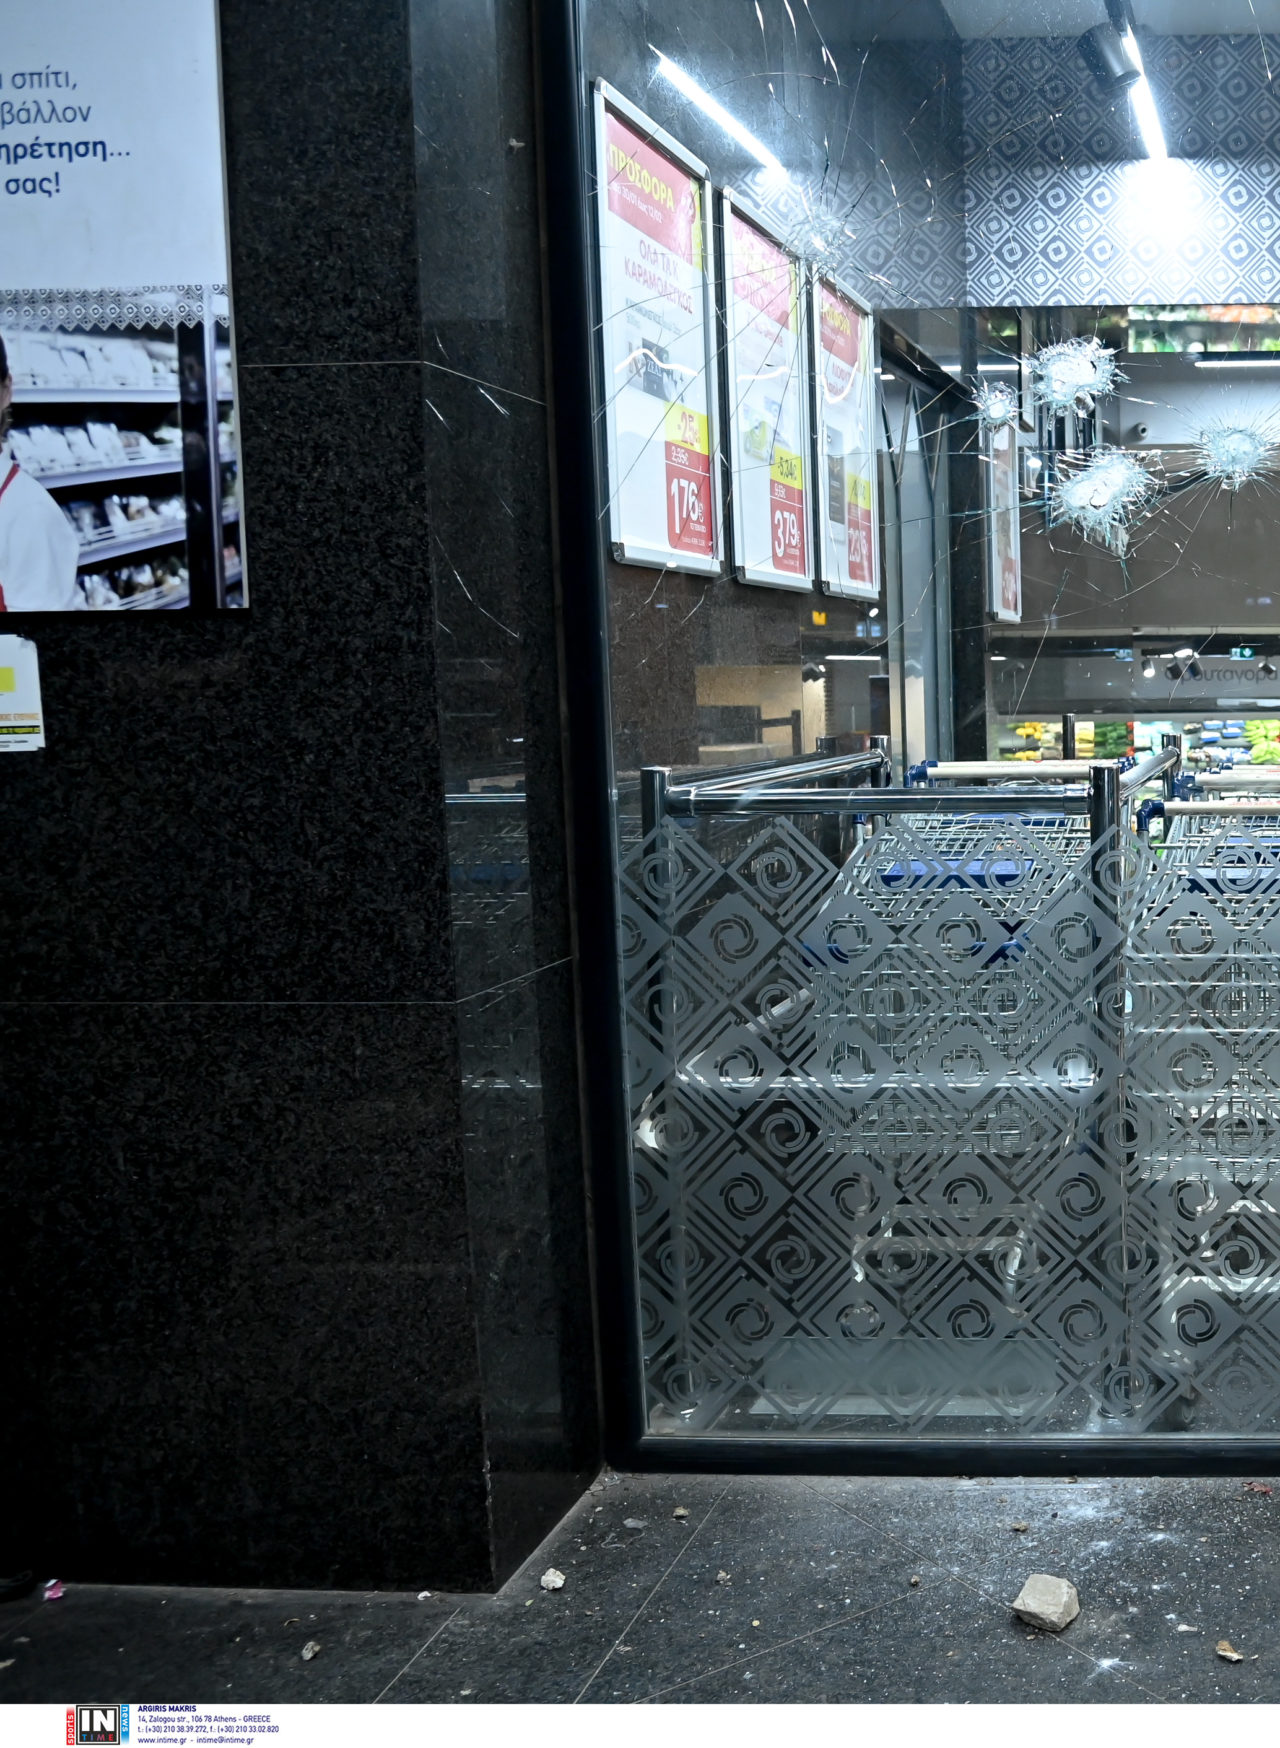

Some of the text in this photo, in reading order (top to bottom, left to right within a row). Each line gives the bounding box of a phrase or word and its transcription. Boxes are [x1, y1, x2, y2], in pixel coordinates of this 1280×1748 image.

[11, 65, 78, 91] σπίτι,
[1, 100, 92, 131] βάλλον
[5, 171, 61, 198] σας!
[609, 143, 676, 212] ΠΡΟΣΦΟΡΑ
